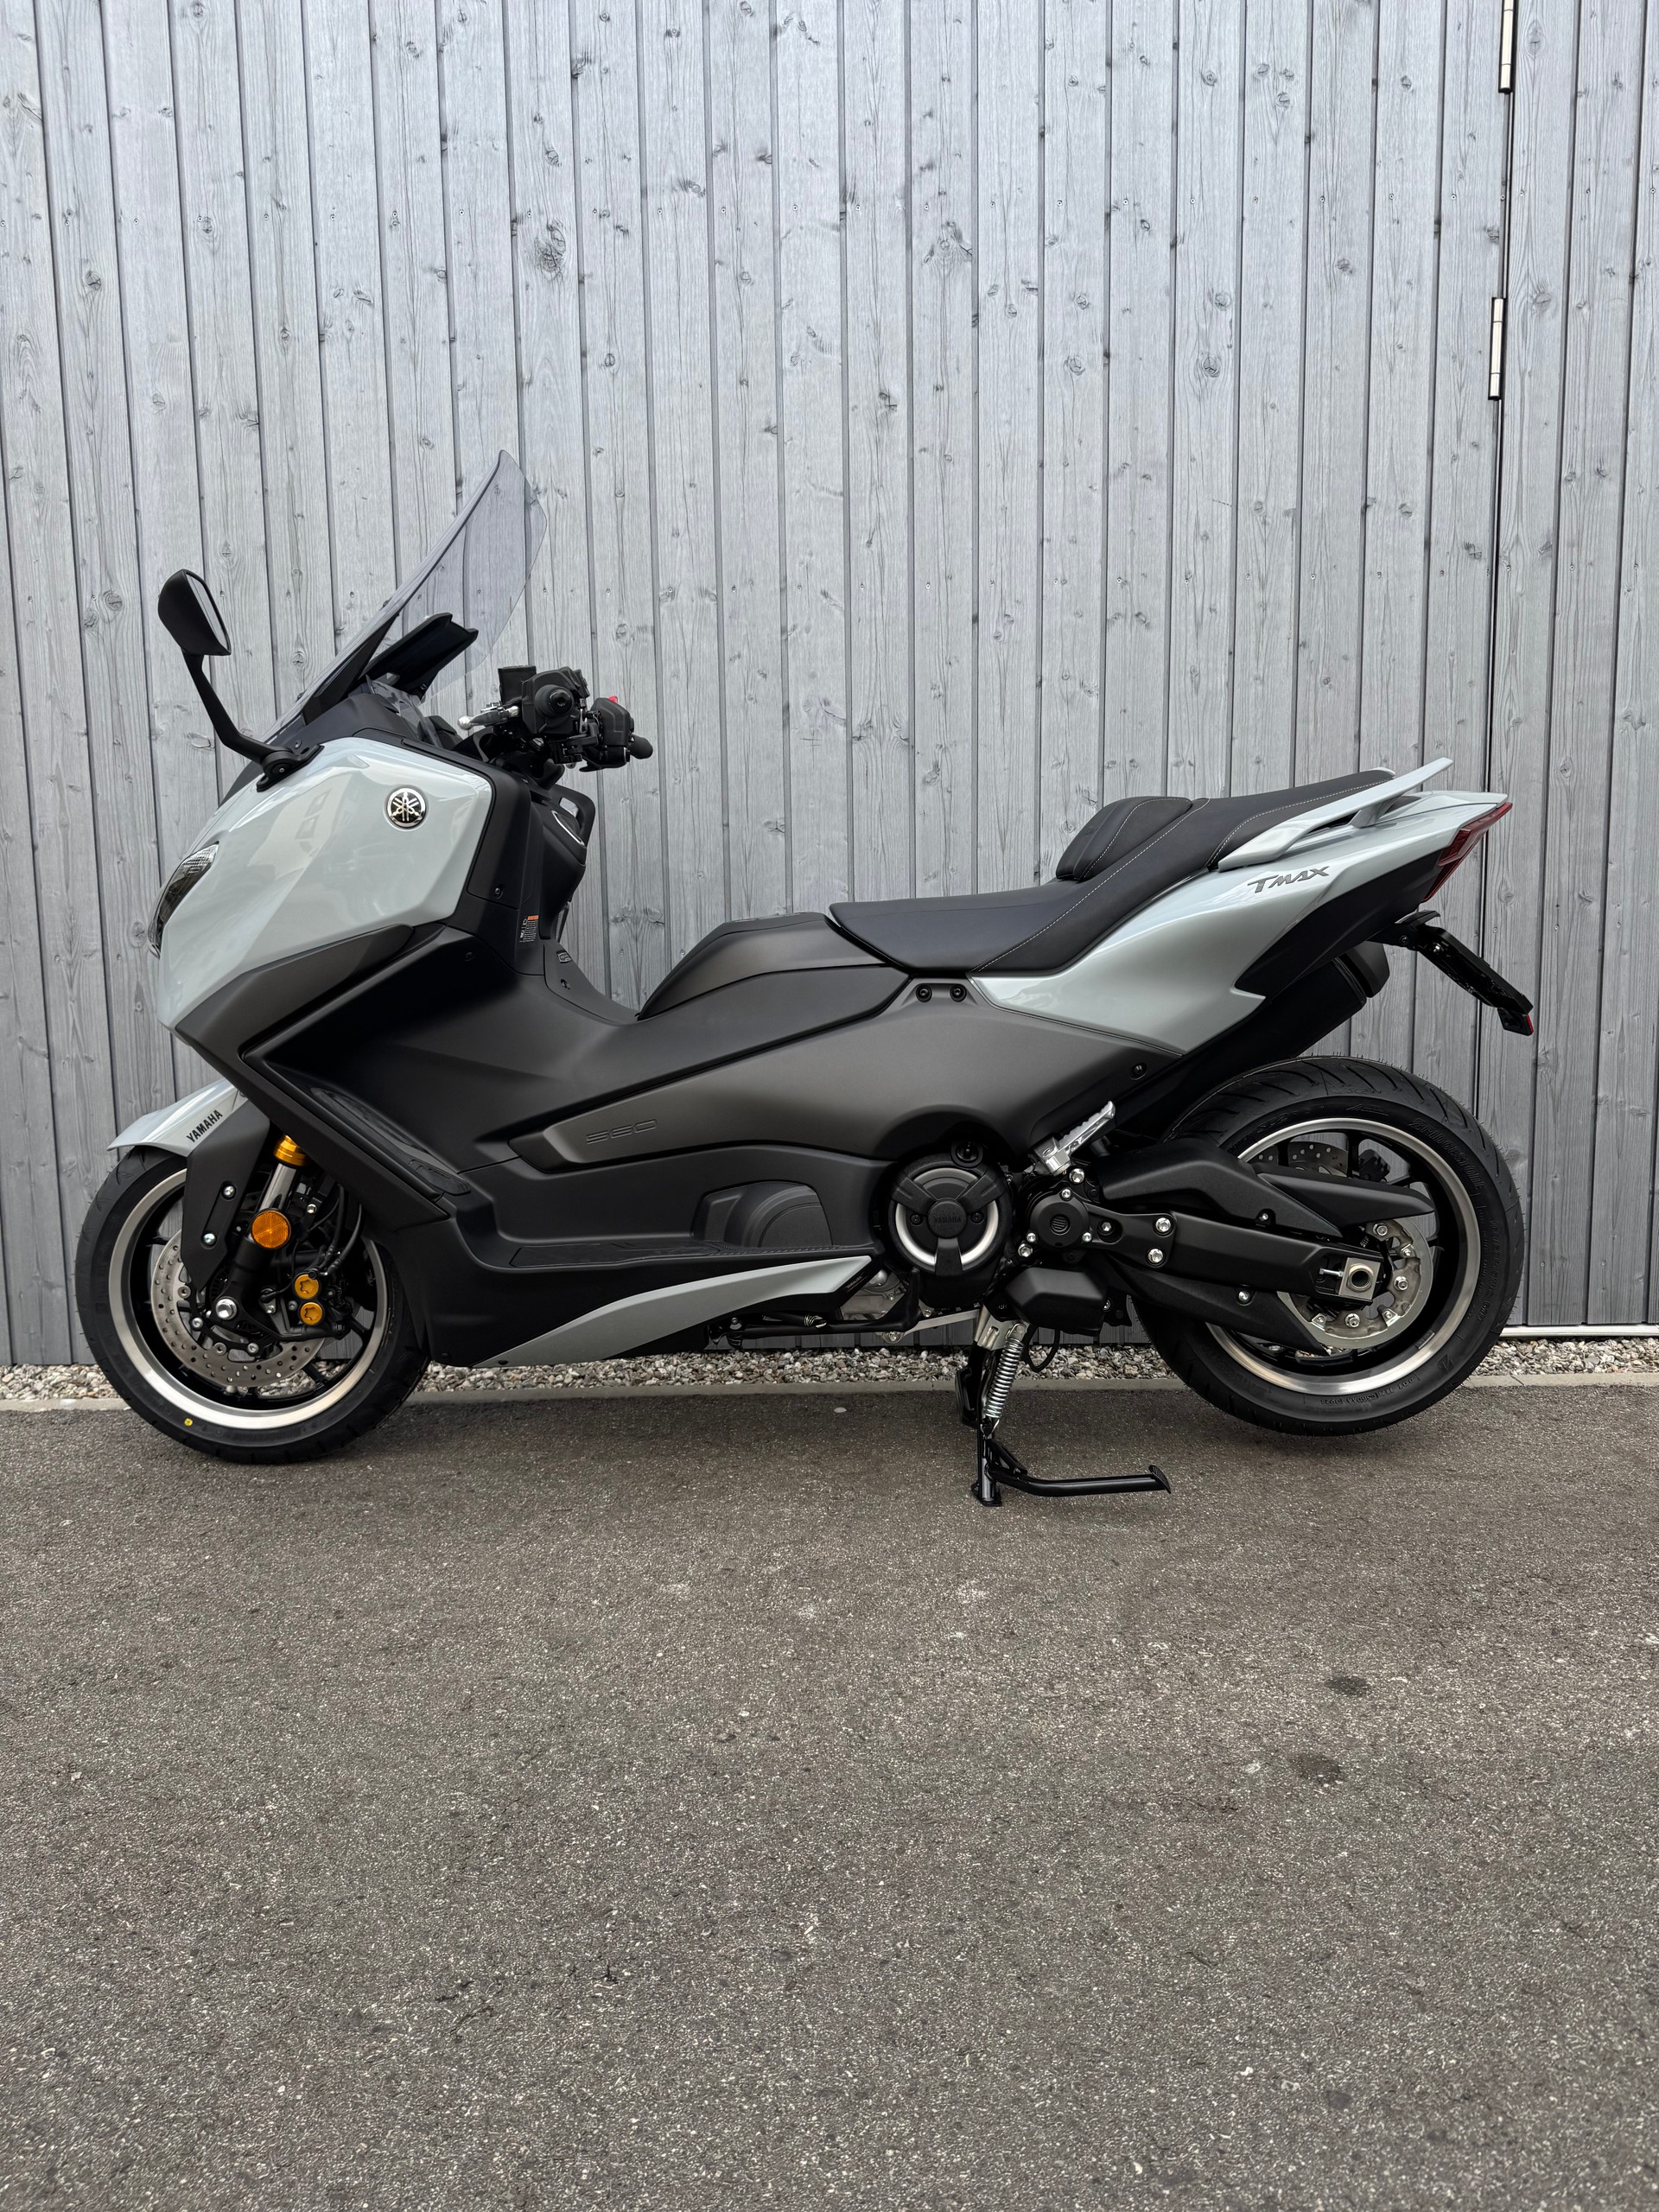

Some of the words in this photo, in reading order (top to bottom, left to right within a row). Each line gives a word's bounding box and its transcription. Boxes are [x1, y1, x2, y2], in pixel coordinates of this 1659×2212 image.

[1247, 865, 1330, 893] TMAX
[186, 1109, 223, 1142] YAMAHA
[586, 1118, 658, 1145] 560
[932, 1215, 962, 1224] YAMAHA
